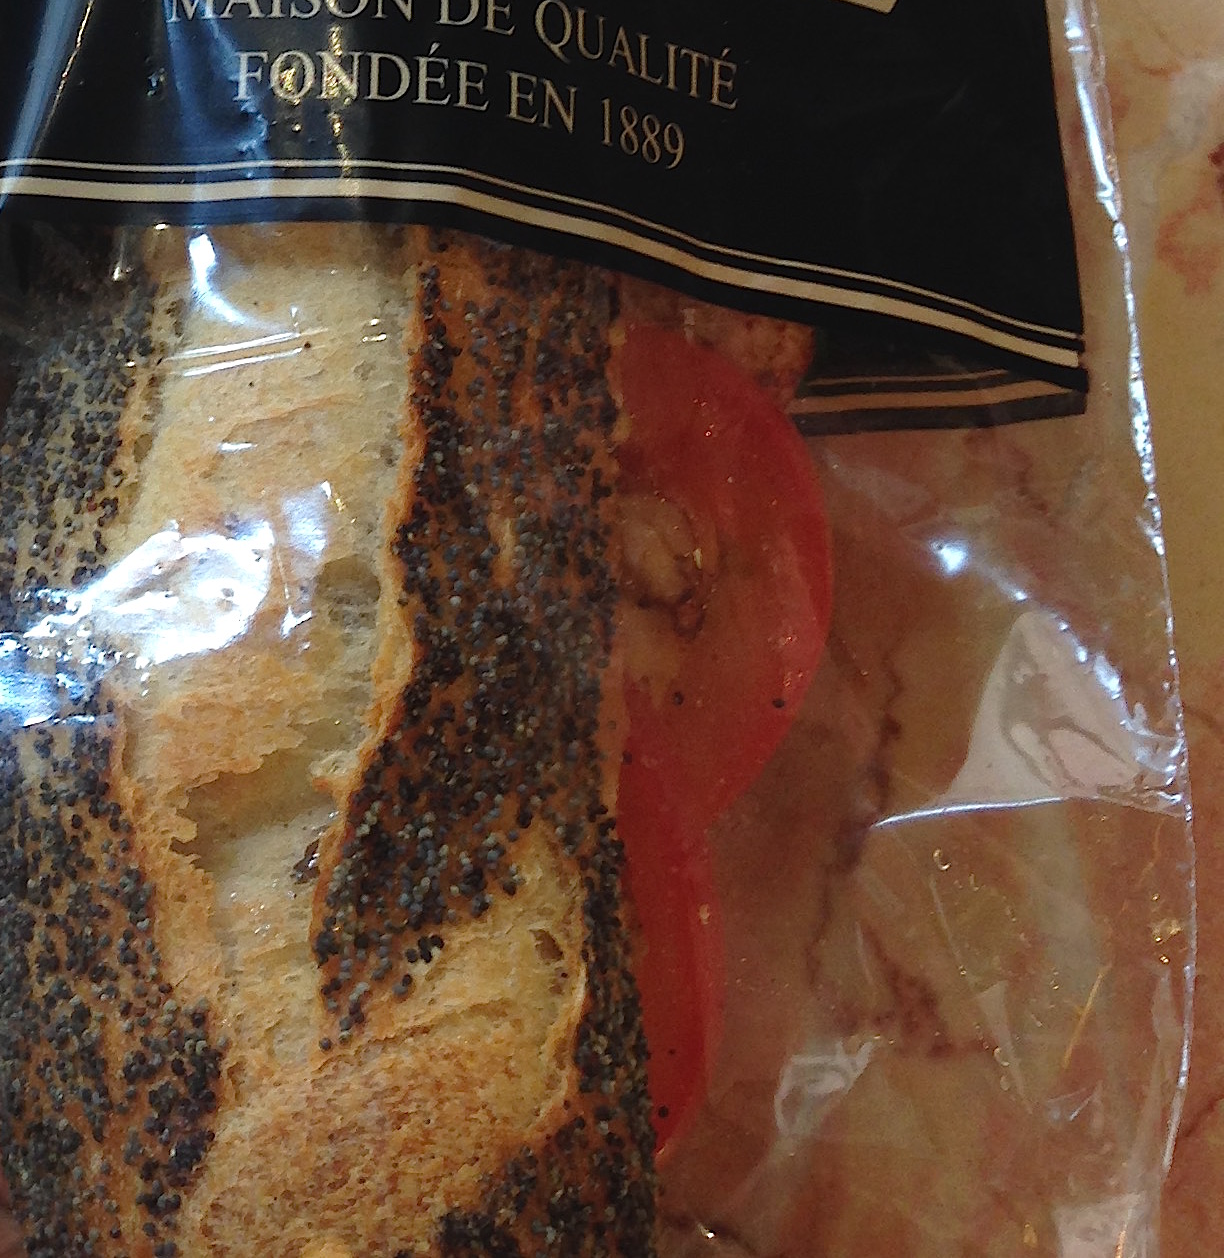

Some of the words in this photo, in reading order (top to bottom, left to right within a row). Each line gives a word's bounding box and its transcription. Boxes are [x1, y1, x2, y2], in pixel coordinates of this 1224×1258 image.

[232, 43, 491, 112] FONDÉE
[505, 69, 578, 136] EN
[599, 97, 686, 171] 1889
